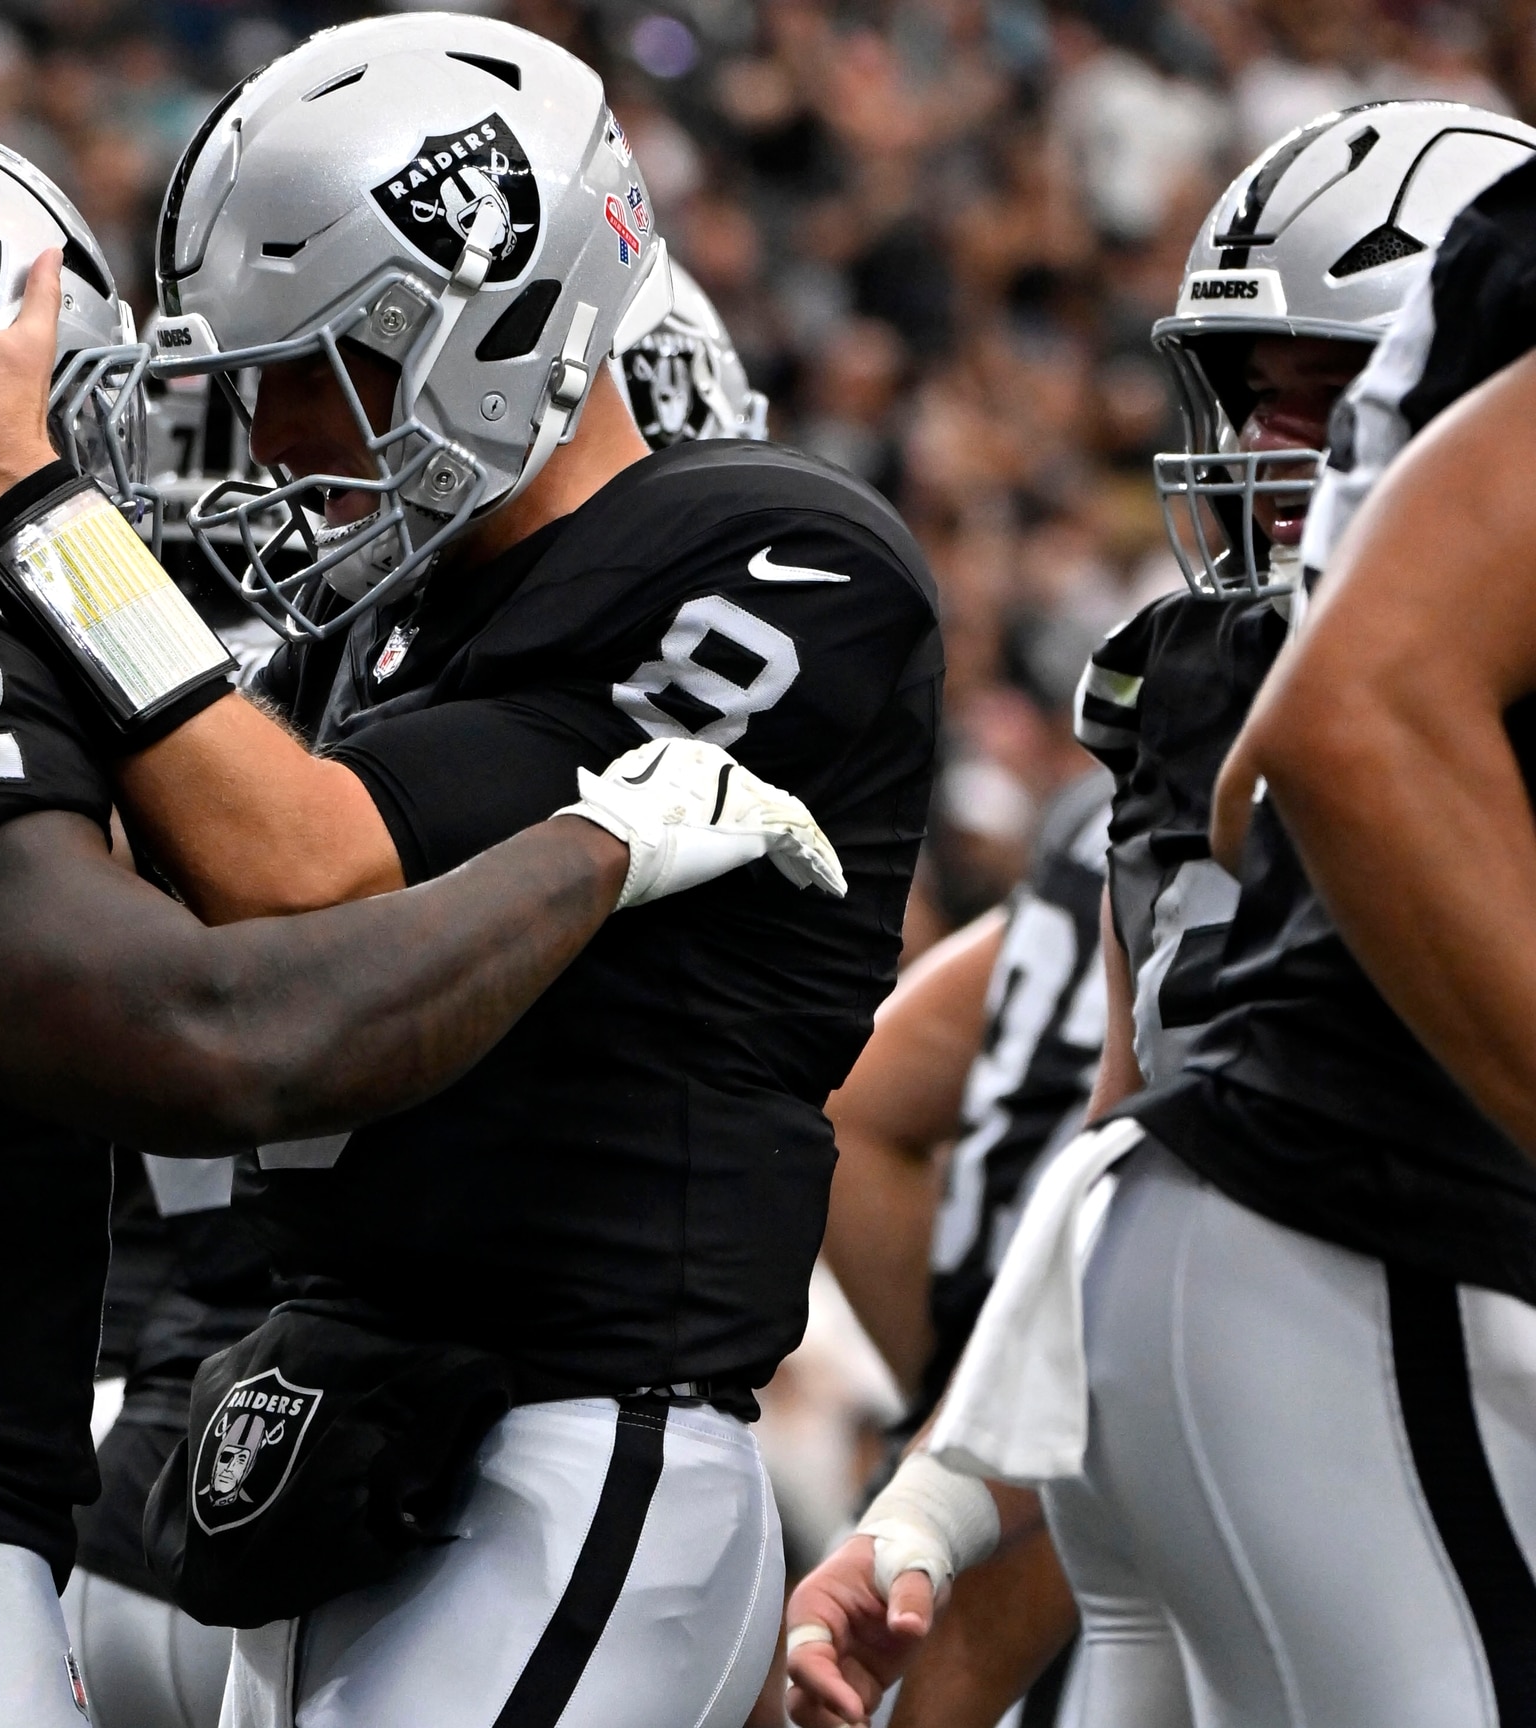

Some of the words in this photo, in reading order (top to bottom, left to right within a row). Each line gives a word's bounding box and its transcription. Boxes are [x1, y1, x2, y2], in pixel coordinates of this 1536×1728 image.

[387, 122, 497, 200] RAIDERS
[1190, 280, 1259, 300] RAIDERS
[612, 594, 801, 750] 8
[227, 1390, 304, 1416] RAIDERS
